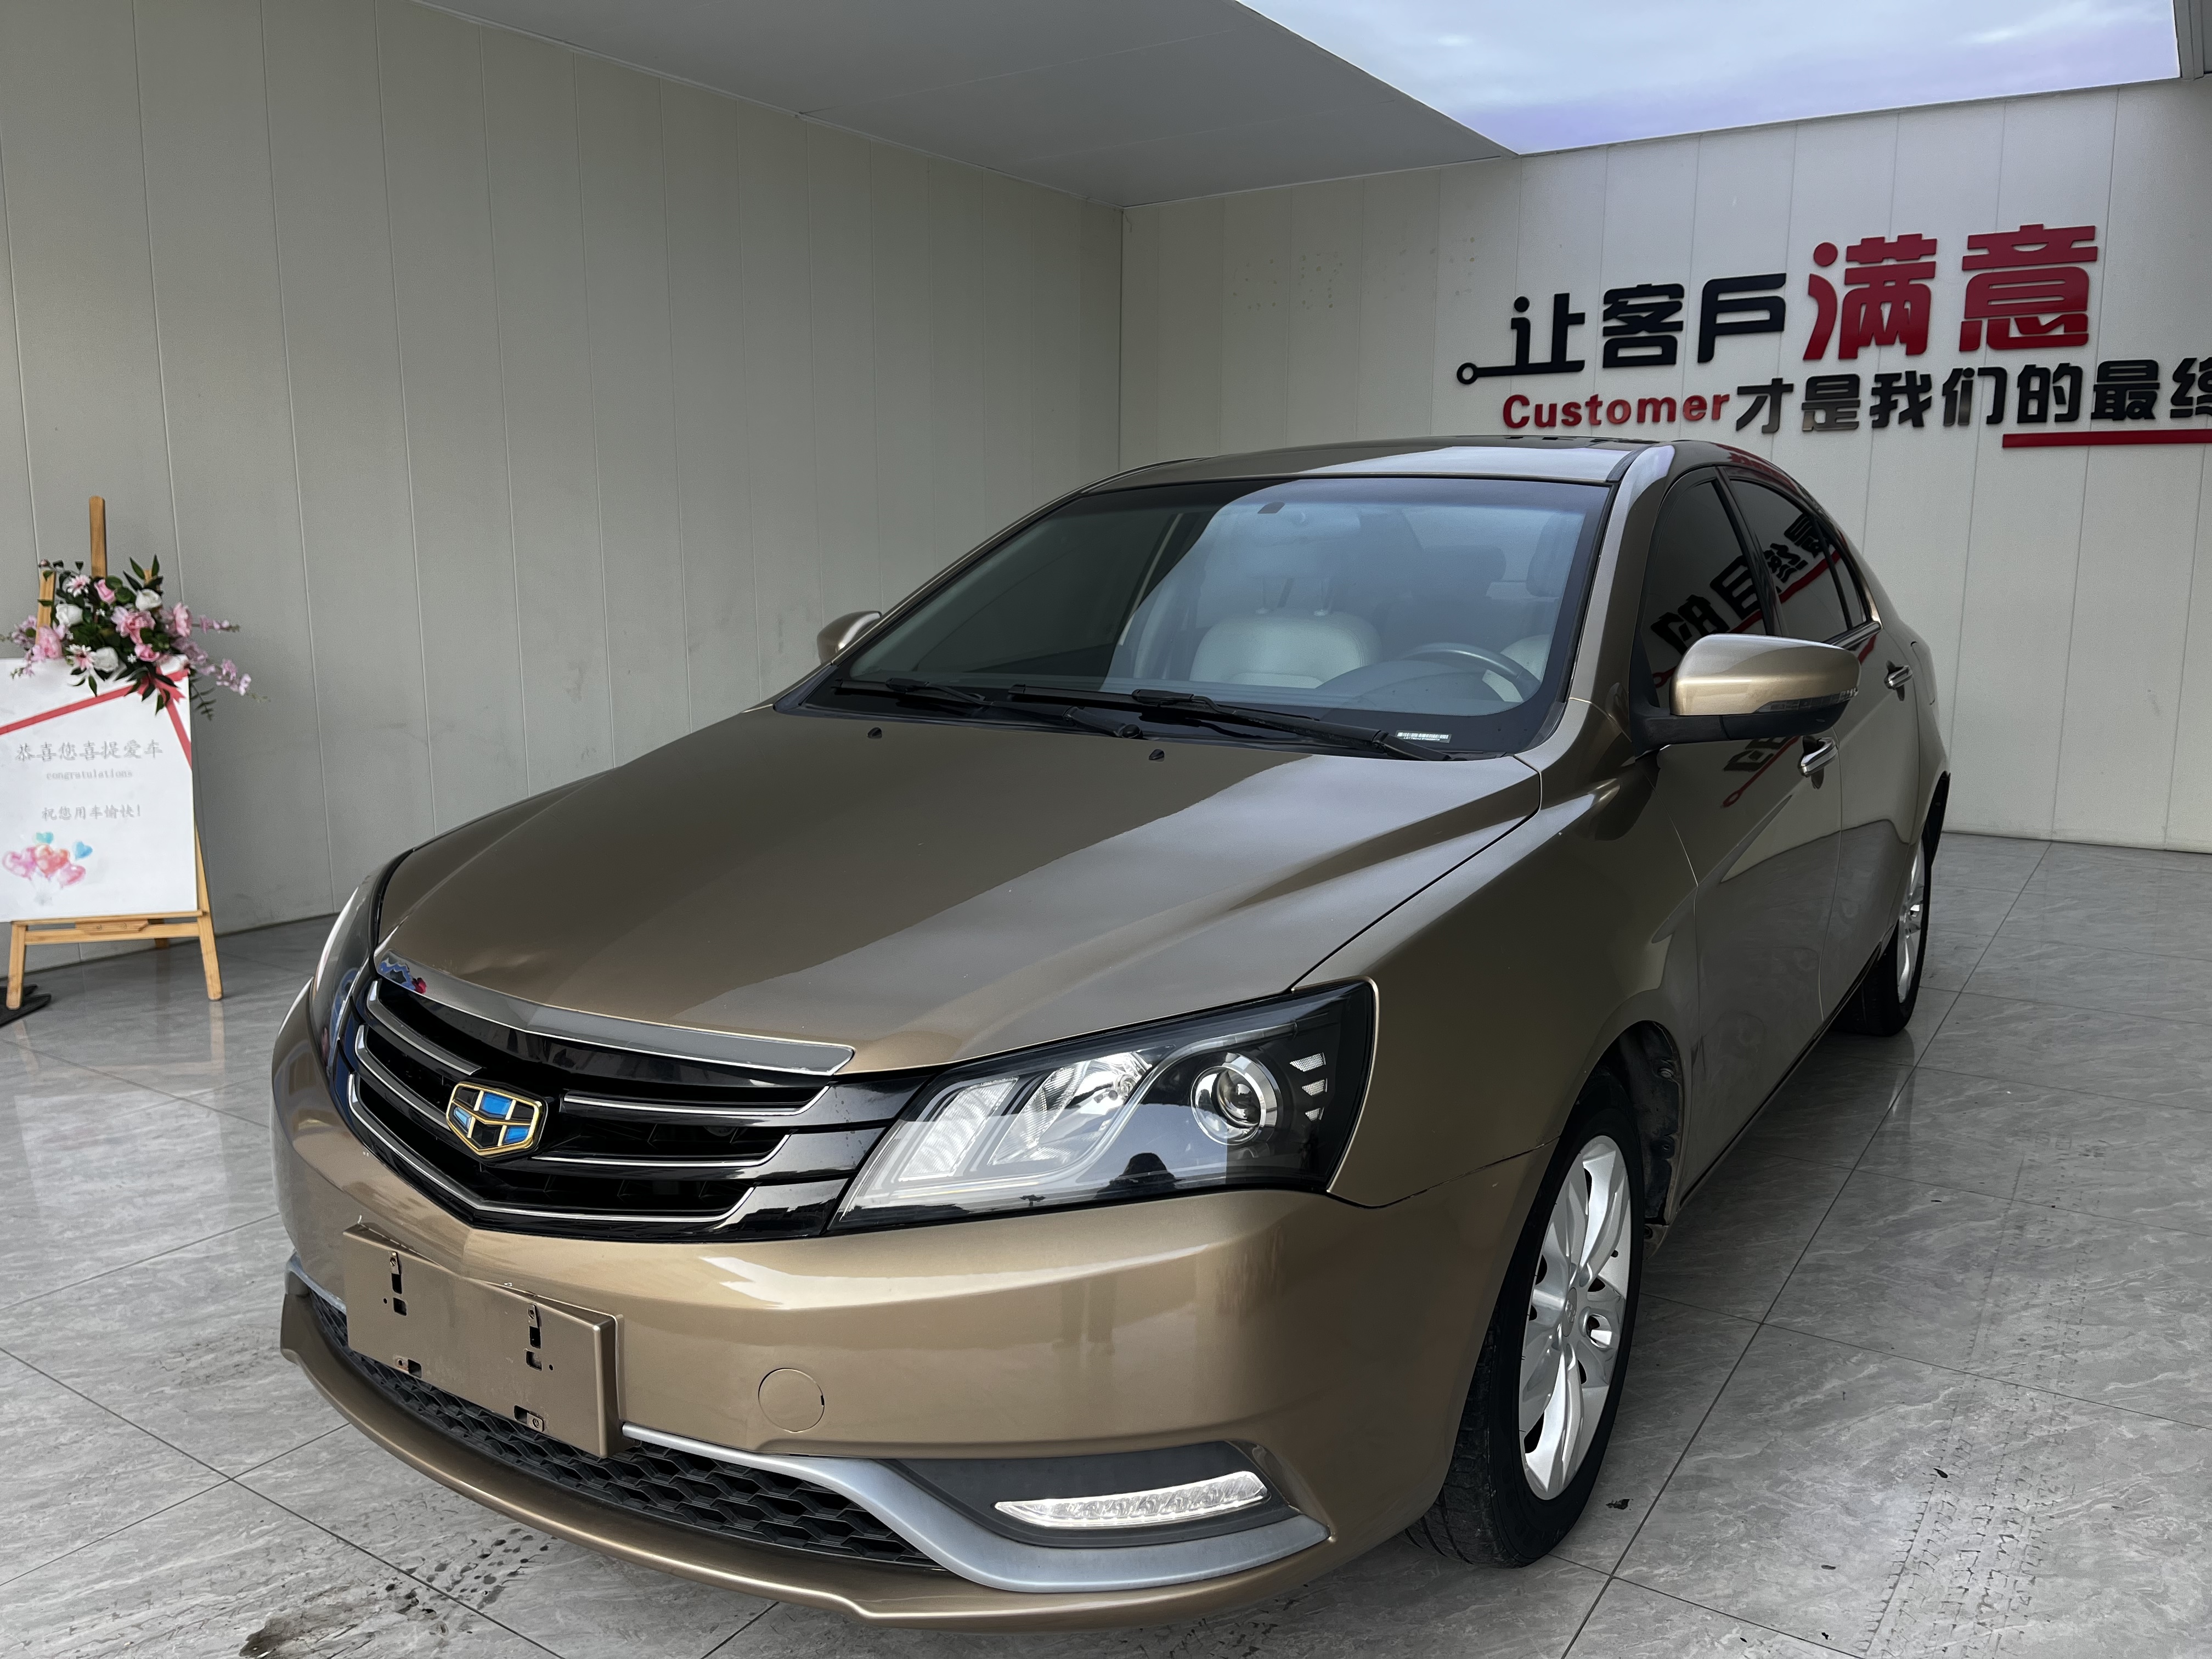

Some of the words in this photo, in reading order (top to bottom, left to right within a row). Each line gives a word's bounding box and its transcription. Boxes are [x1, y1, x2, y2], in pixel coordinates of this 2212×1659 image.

[1457, 224, 2098, 385] 让客户满意
[1503, 393, 1730, 429] Customer
[15, 739, 163, 763] 恭喜您喜提爱车
[46, 768, 133, 780] congratulations
